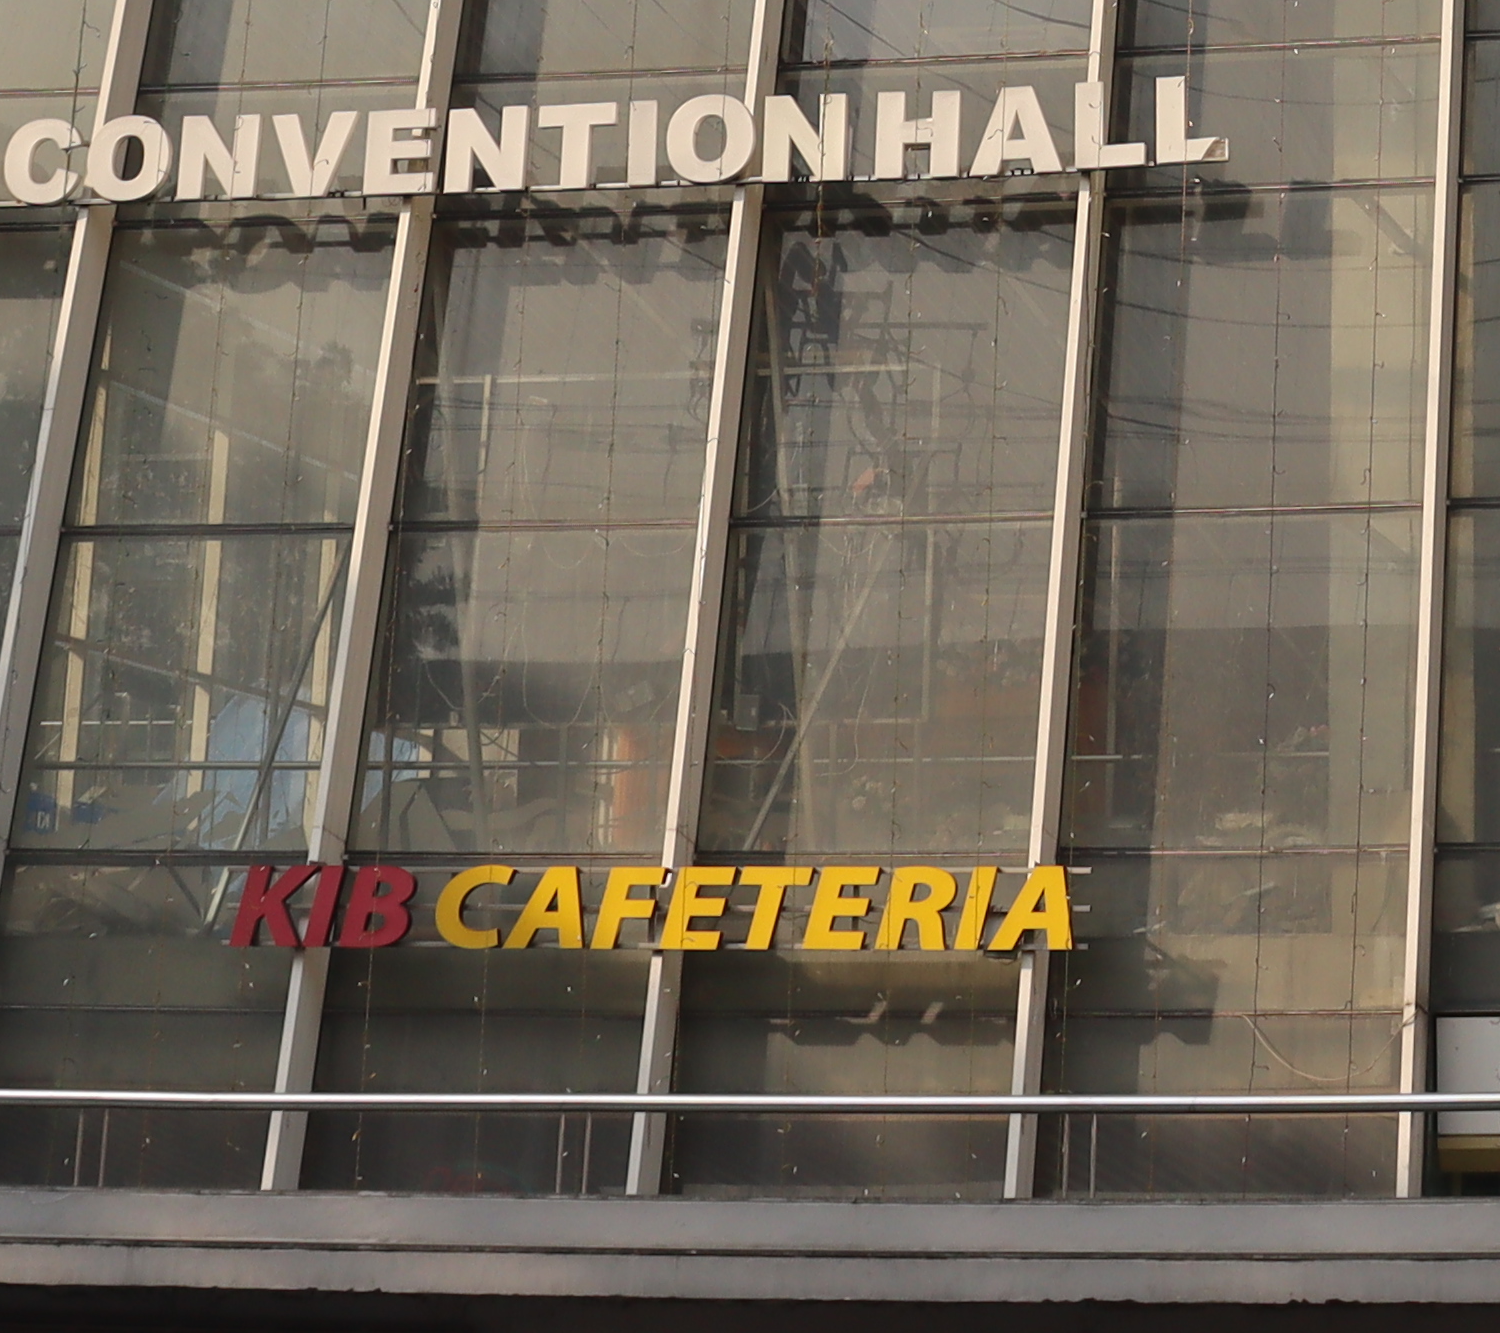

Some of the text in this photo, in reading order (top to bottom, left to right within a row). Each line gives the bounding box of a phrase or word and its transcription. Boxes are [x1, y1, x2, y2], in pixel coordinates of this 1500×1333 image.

[3, 92, 849, 206] CONVENTION
[874, 76, 1229, 179] HALL
[229, 864, 1074, 950] KIB CAFETERIA
